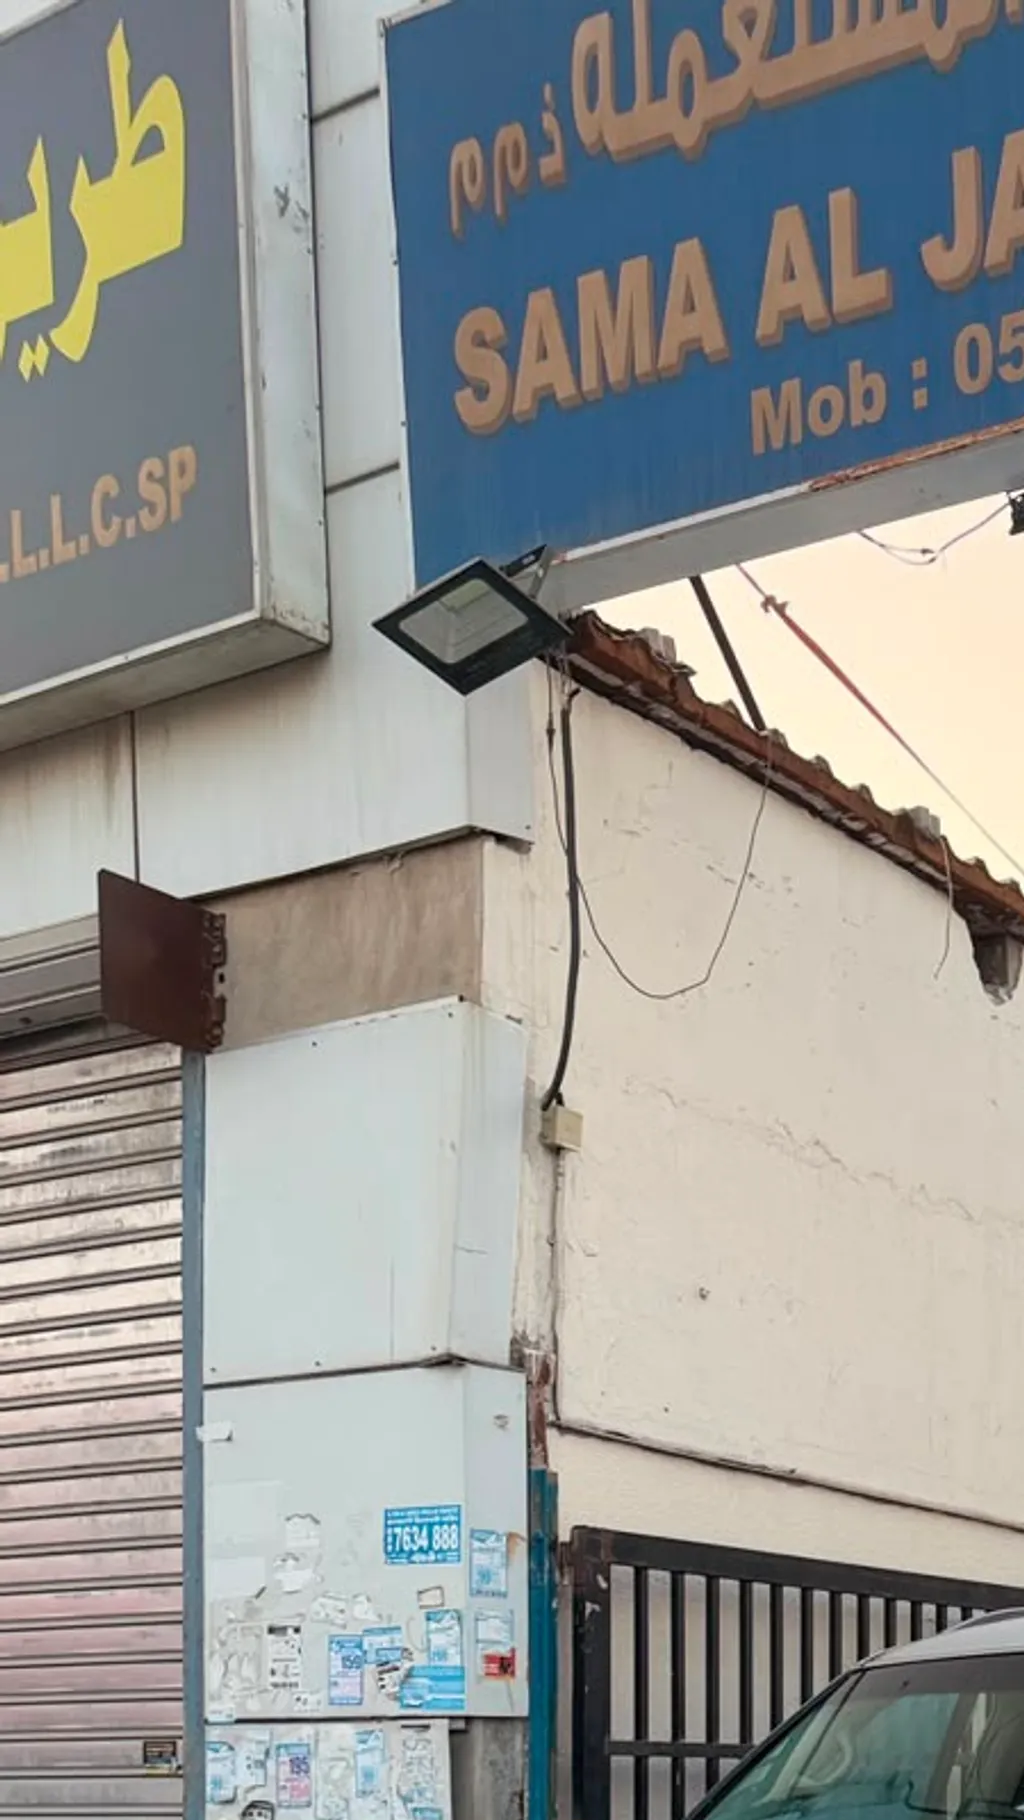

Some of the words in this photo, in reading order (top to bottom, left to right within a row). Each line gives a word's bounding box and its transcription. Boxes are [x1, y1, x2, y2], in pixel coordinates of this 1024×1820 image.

[0, 18, 185, 382] طري
[453, 238, 730, 437] SAMA
[754, 187, 892, 347] AL
[750, 360, 887, 456] Mob
[393, 1524, 429, 1552] 7634
[432, 1522, 459, 1551] 888
